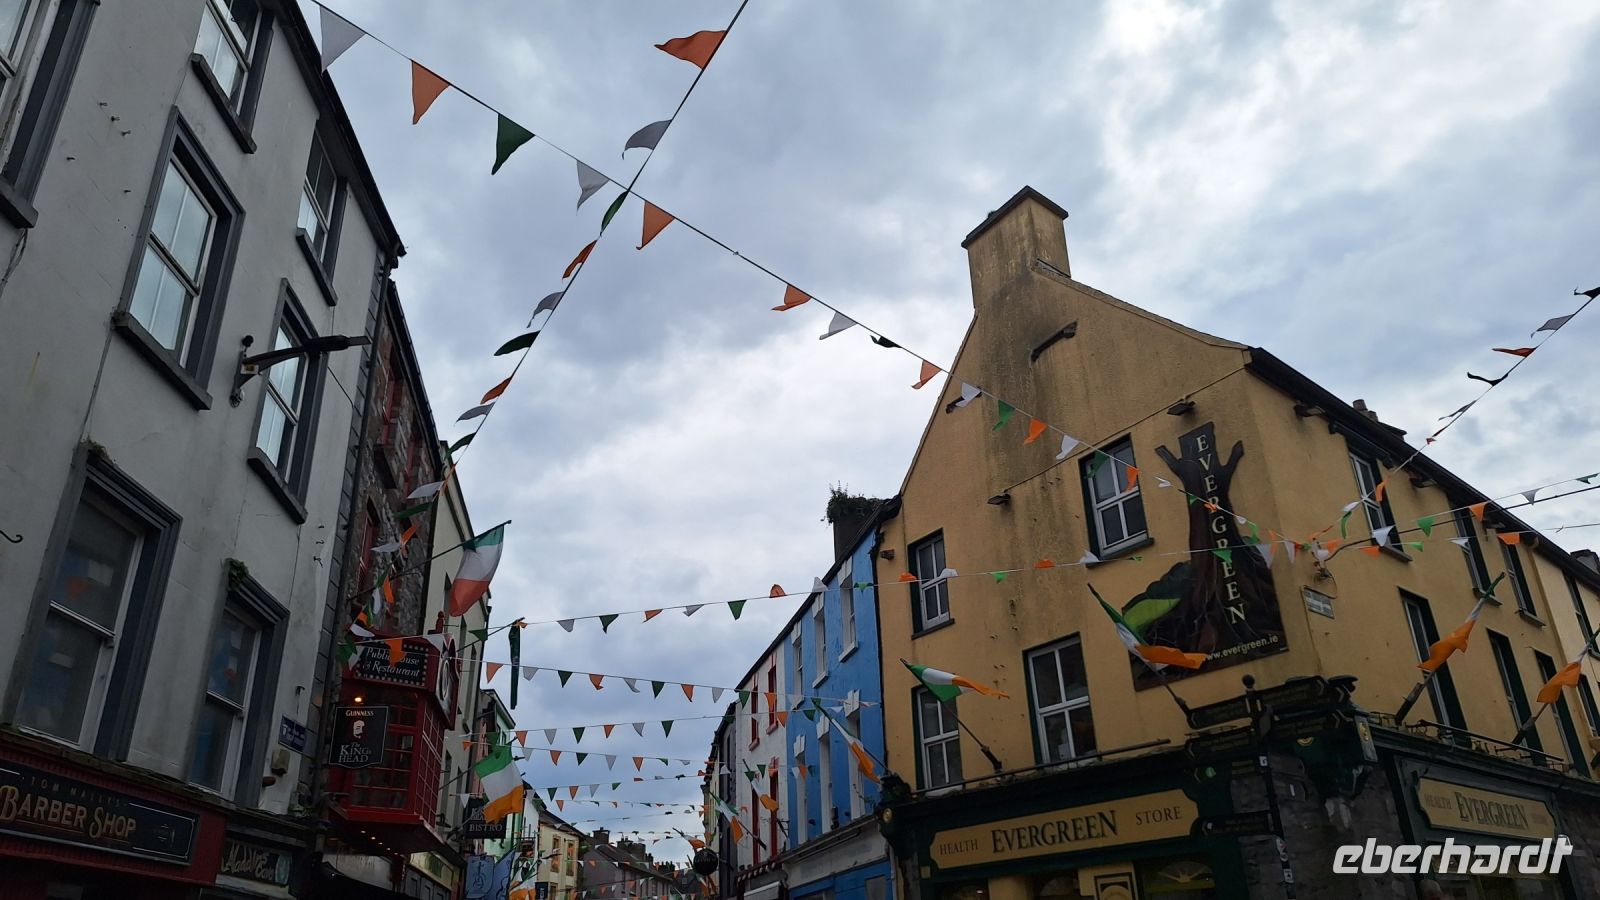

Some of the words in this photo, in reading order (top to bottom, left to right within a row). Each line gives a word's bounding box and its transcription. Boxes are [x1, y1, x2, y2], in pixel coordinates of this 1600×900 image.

[345, 709, 376, 717] GUINNESS
[338, 754, 369, 763] HEAD
[31, 776, 60, 792] TOM
[0, 785, 88, 831] BARBER
[88, 806, 137, 841] SHOP
[1454, 792, 1529, 830] EVERGREEN
[469, 823, 503, 832] BISTRO
[939, 839, 979, 855] HEALTH
[991, 810, 1119, 854] EVERGREEN
[1136, 805, 1183, 826] STORE
